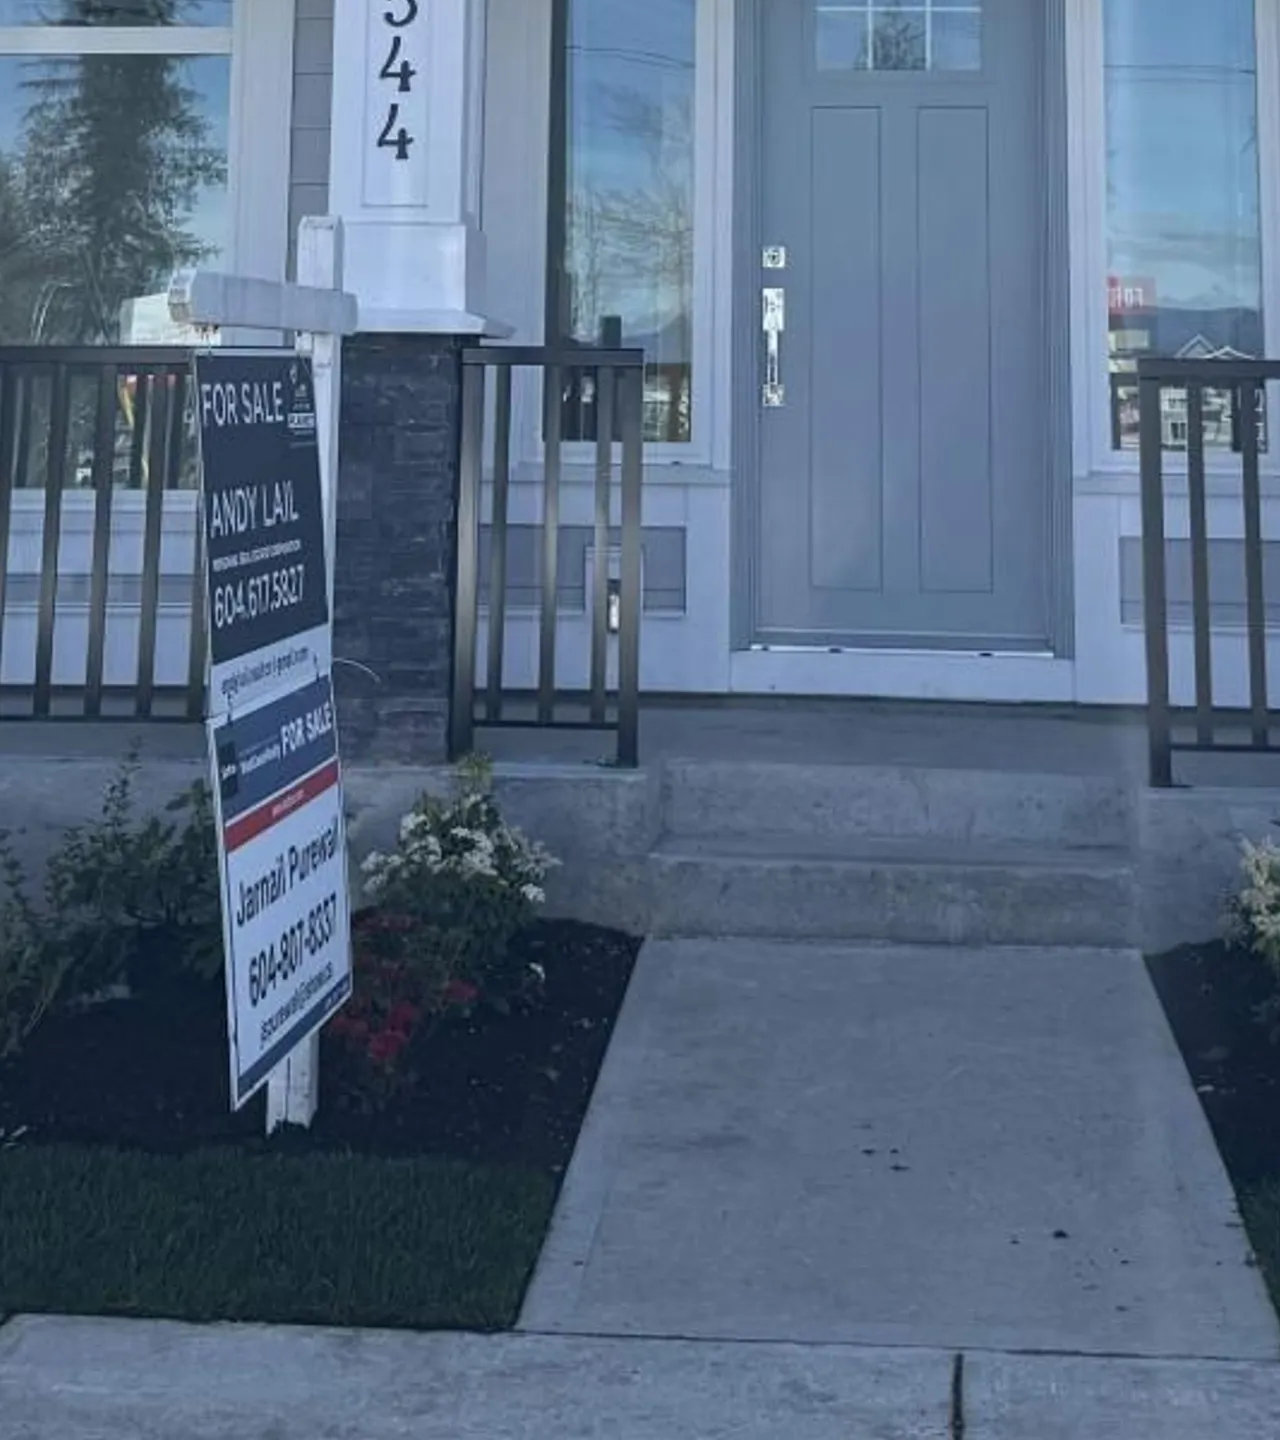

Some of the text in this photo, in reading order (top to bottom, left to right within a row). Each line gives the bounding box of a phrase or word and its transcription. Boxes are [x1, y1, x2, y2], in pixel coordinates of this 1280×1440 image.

[200, 383, 238, 428] FOR
[241, 381, 285, 424] SALE
[210, 485, 258, 539] ANDY
[280, 716, 306, 760] FOR
[306, 702, 333, 743] SALE
